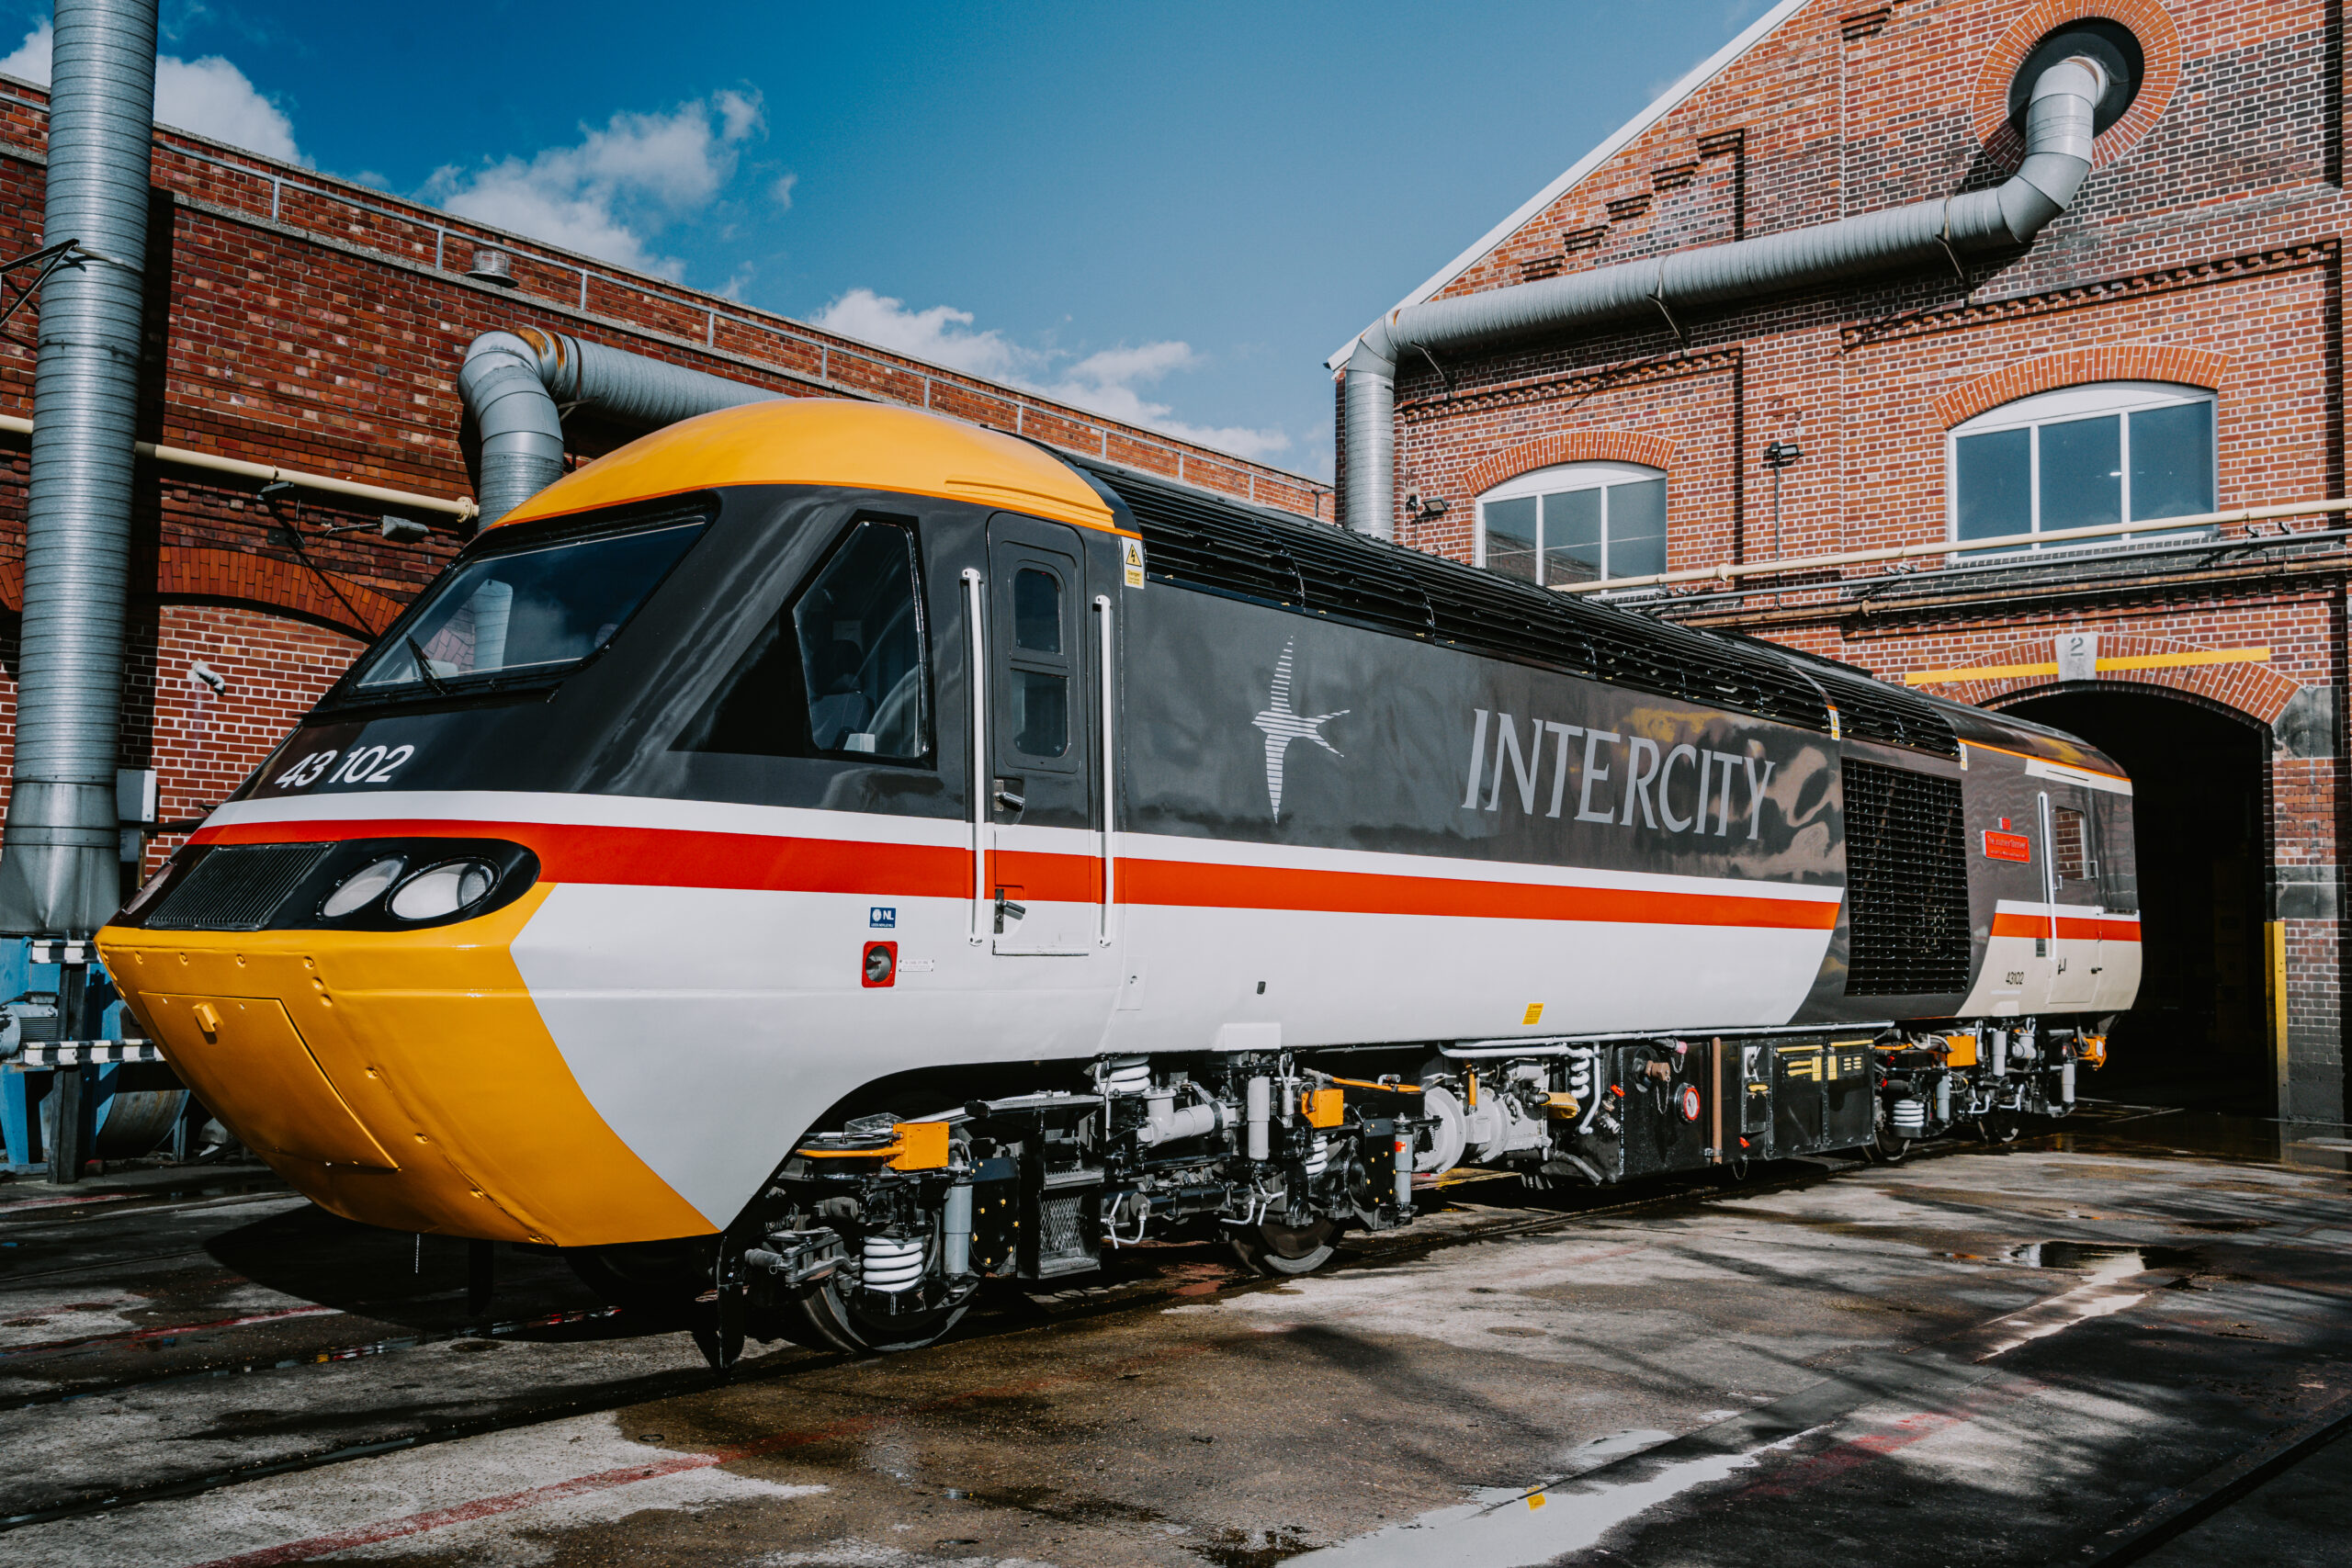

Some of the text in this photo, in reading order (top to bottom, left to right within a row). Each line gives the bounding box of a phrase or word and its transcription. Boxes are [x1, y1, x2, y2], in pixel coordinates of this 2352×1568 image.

[2071, 637, 2084, 657] 2
[274, 744, 415, 788] 43 102
[1461, 708, 1776, 840] INTERCITY
[883, 909, 894, 920] NL
[2006, 971, 2024, 985] 43102
